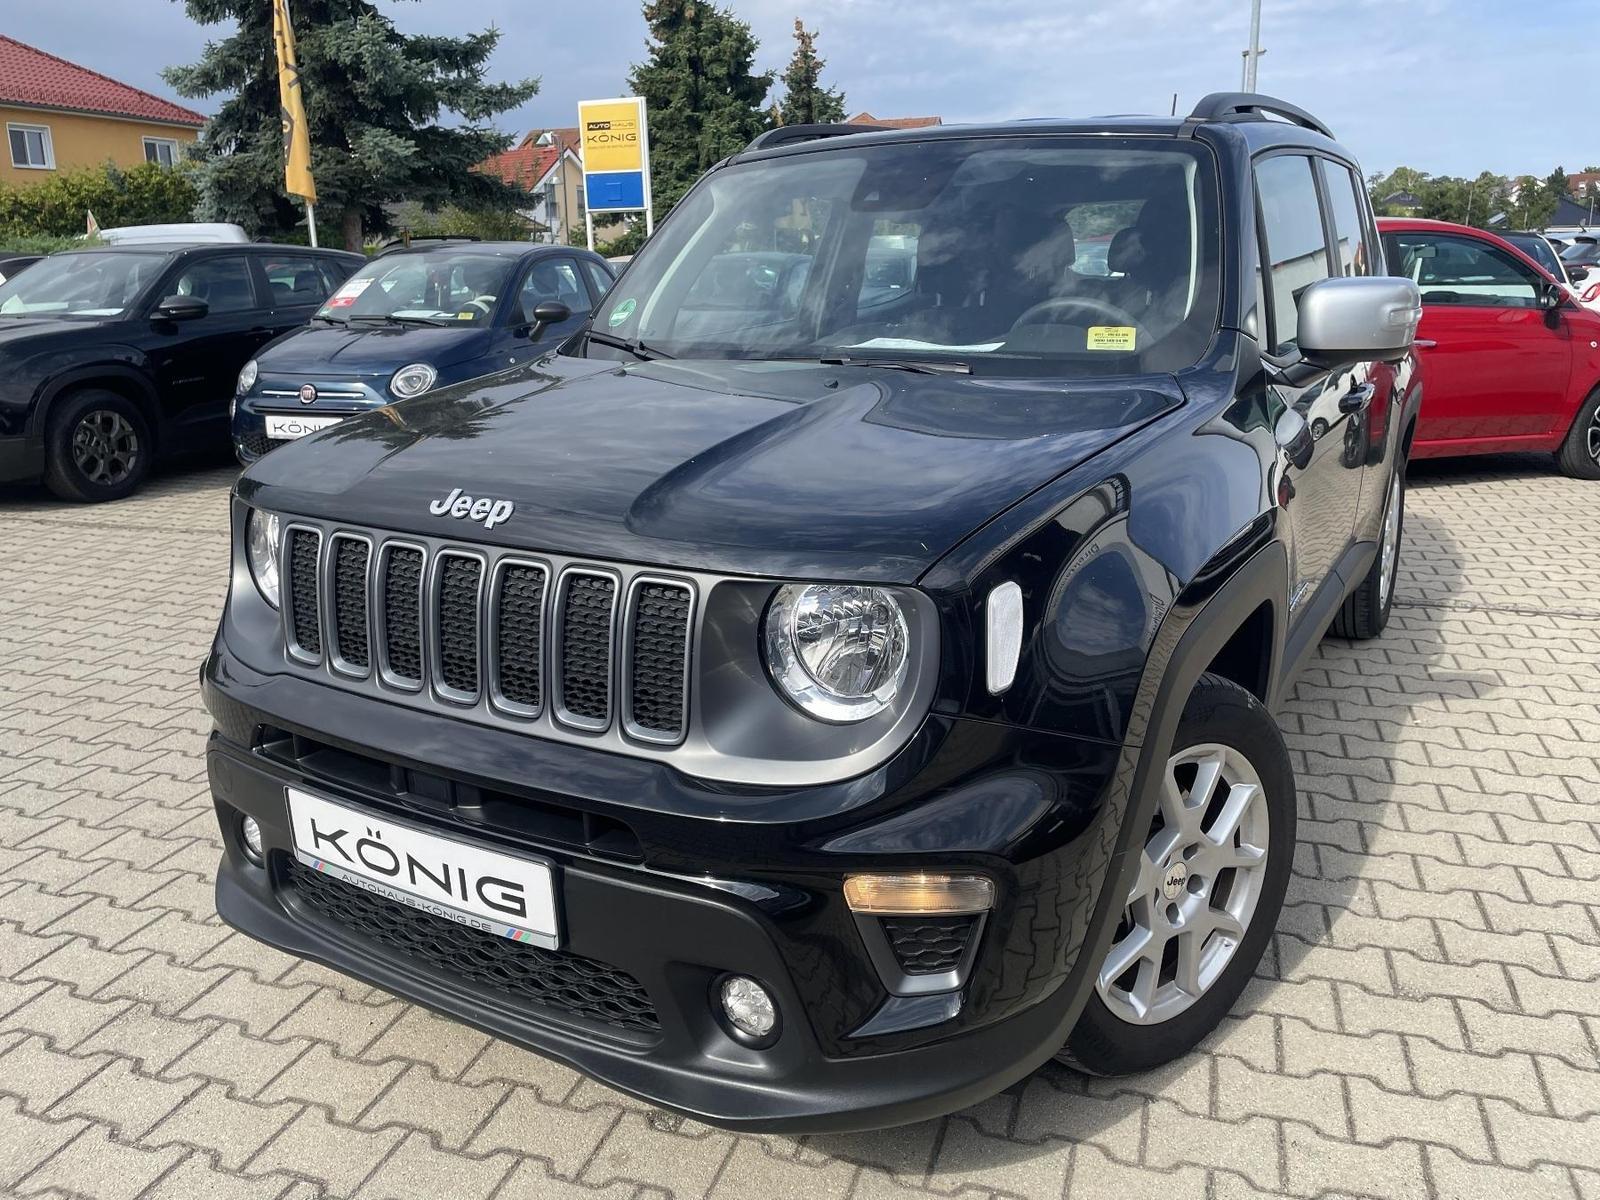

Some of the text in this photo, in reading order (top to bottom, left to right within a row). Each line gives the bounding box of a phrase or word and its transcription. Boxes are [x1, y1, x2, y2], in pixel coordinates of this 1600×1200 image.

[588, 122, 610, 130] AUTO
[587, 132, 637, 144] KÖNIG
[273, 420, 324, 433] KÖNI
[429, 487, 515, 530] Jeep
[310, 818, 527, 918] KÖNIG
[1167, 876, 1186, 886] Jeep
[342, 873, 493, 932] AUTOHAUS-KÖNIG.DE
